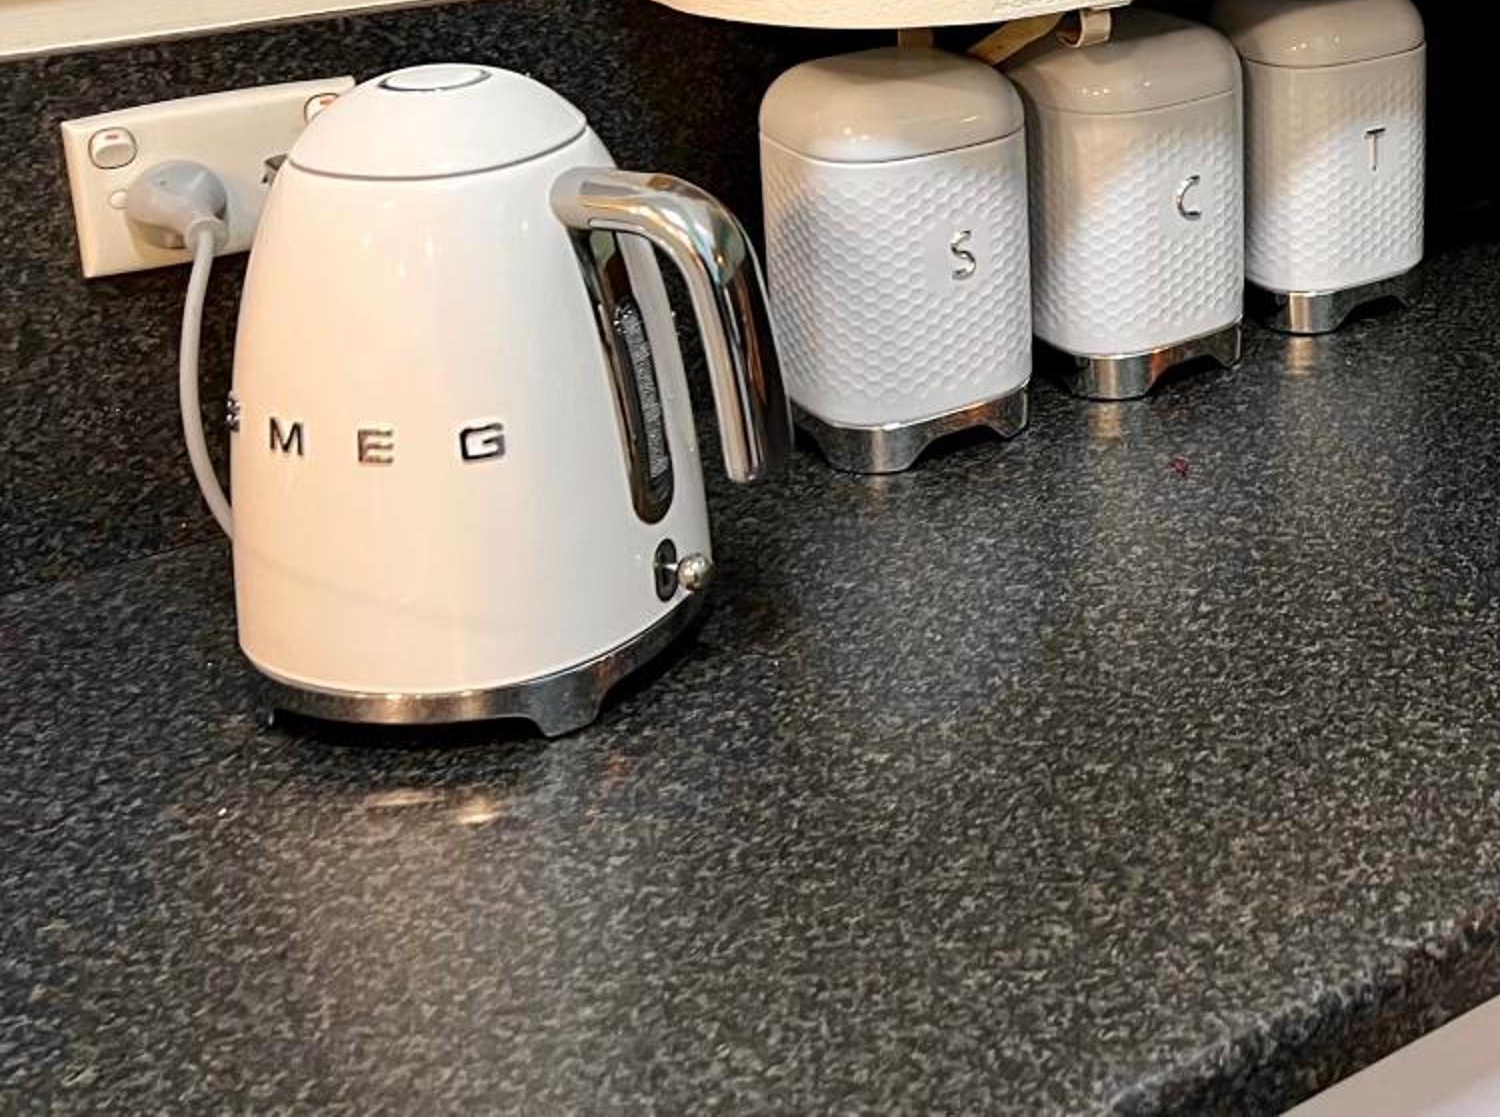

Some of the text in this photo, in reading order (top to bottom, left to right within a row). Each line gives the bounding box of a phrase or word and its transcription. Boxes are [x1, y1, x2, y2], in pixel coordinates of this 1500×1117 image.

[1363, 126, 1387, 172] T
[1175, 174, 1202, 221] C
[949, 229, 977, 280] S
